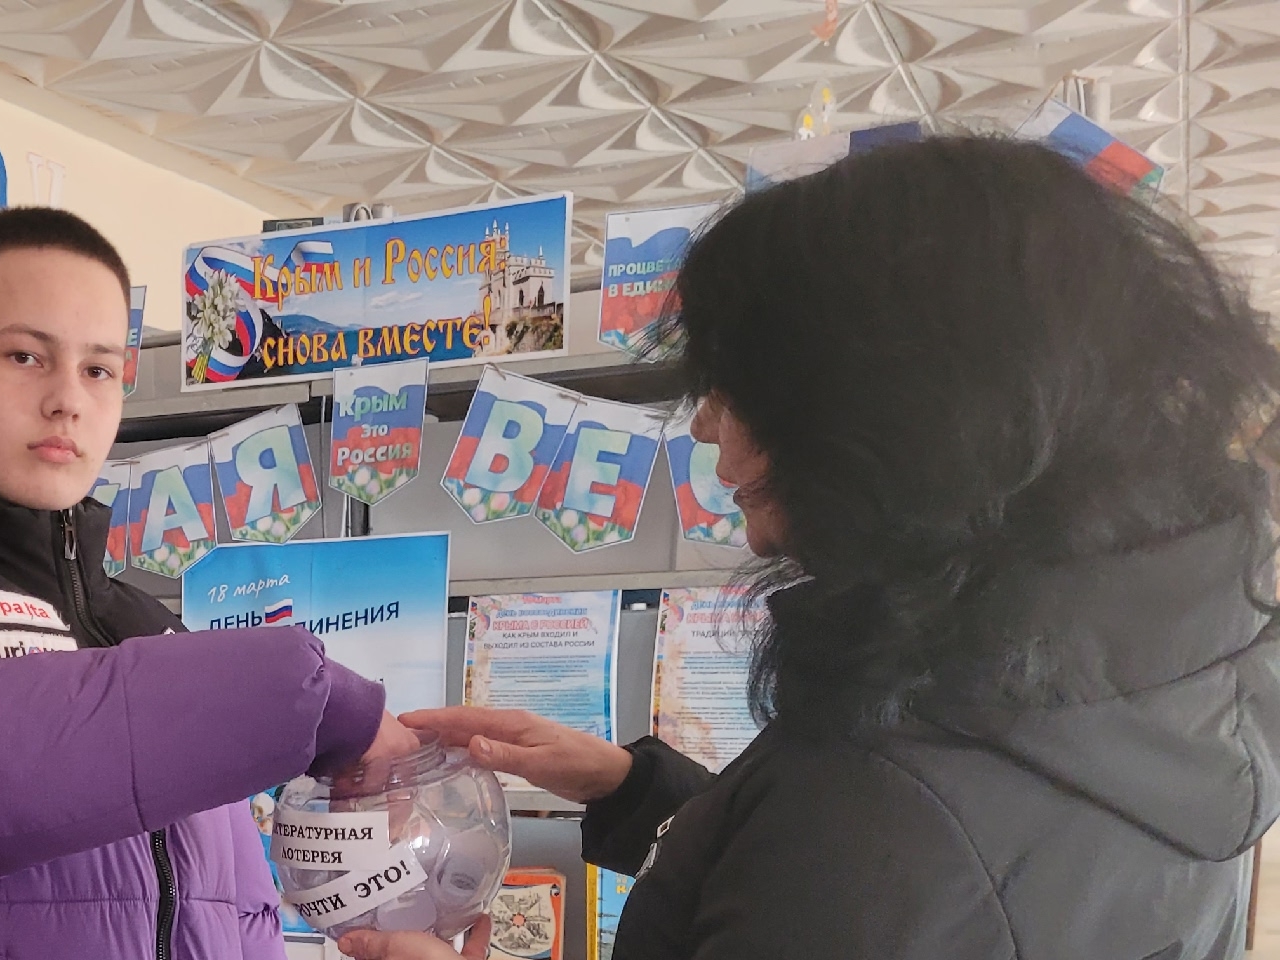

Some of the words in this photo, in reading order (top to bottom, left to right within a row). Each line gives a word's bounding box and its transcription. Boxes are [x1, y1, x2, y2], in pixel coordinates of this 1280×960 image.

[250, 254, 344, 311] Крым
[353, 256, 371, 288] и
[608, 283, 618, 298] В
[207, 584, 229, 603] 18
[233, 573, 291, 598] марта
[281, 847, 343, 864] ЛОТЕРЕЯ
[353, 859, 411, 899] ЭТО!
